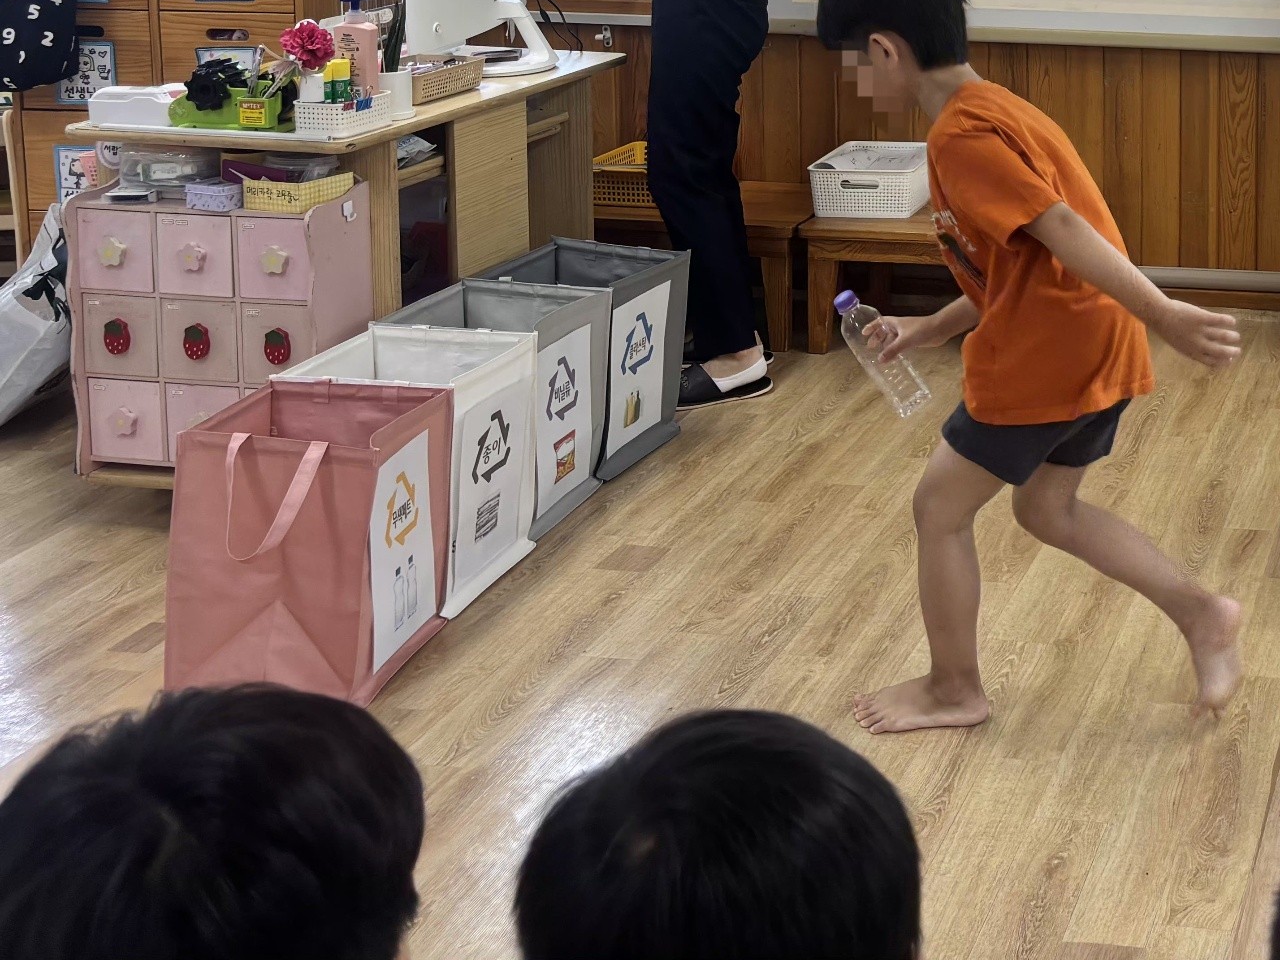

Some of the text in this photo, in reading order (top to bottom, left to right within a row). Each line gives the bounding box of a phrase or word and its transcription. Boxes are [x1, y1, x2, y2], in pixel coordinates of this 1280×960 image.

[28, 4, 40, 19] 5
[2, 28, 16, 44] 9
[40, 31, 54, 47] 2
[247, 186, 273, 200] 머리카락
[554, 381, 571, 403] 비닐류
[483, 437, 501, 464] 종이
